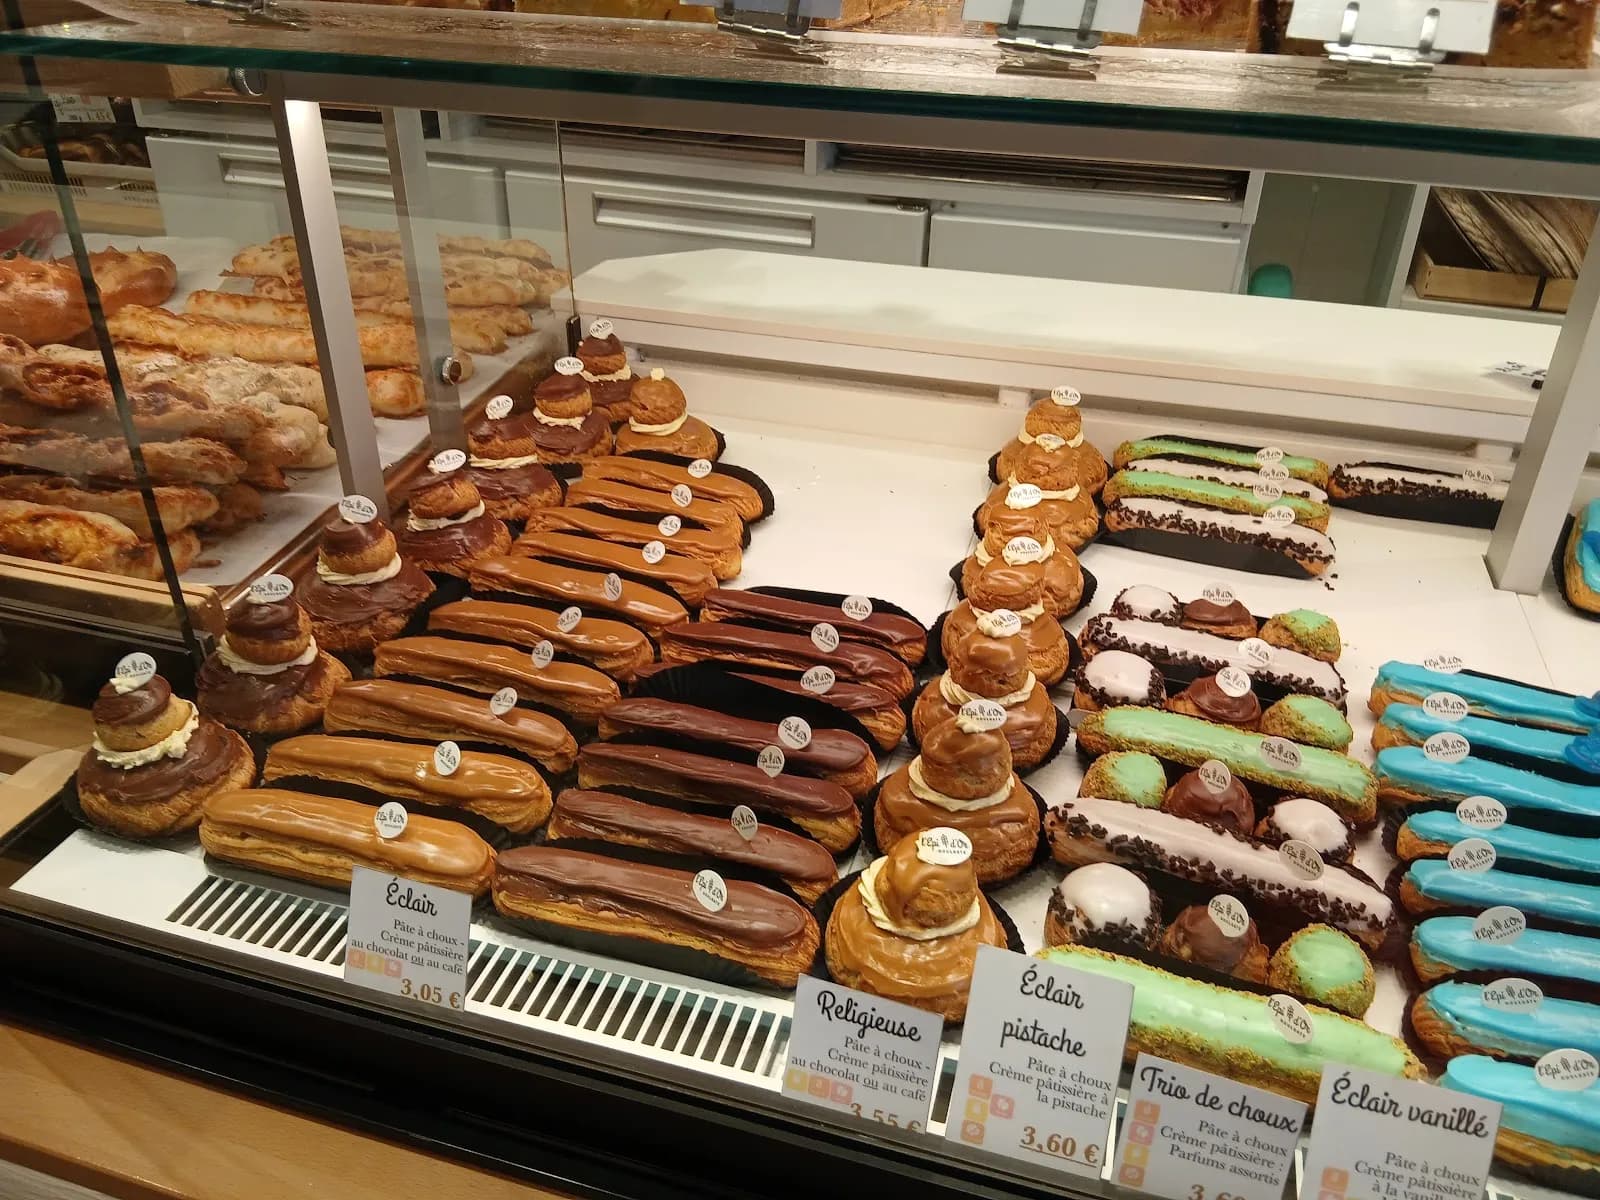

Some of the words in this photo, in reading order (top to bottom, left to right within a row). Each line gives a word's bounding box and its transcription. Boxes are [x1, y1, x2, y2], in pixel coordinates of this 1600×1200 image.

[386, 877, 437, 916] Éclair
[381, 930, 415, 948] Crème
[417, 942, 464, 961] pâtissière
[393, 919, 415, 934] Pâte
[418, 926, 424, 936] à
[427, 928, 457, 946] choux
[352, 938, 363, 949] au
[367, 940, 408, 961] chocolat
[411, 955, 424, 964] ou
[427, 958, 439, 968] au
[442, 964, 463, 975] café
[401, 979, 442, 1004] 3,05
[450, 992, 460, 1009] €
[1020, 964, 1084, 1009] Éclair
[817, 990, 921, 1042] Religieuse
[844, 1036, 870, 1053] Pâte
[874, 1046, 880, 1057] à
[884, 1050, 922, 1070] choux
[1000, 1018, 1086, 1057] pistache
[792, 1056, 806, 1067] au
[809, 1059, 859, 1083] chocolat
[863, 1078, 878, 1089] ou
[882, 1082, 897, 1094] au
[901, 1086, 926, 1102] café
[828, 1048, 868, 1069] Crème
[872, 1063, 928, 1087] pâtissière
[989, 1061, 1033, 1084] Crème
[1036, 1077, 1097, 1103] pâtissière
[1101, 1092, 1109, 1106] à
[1028, 1056, 1056, 1076] Pâte
[1059, 1066, 1067, 1079] à
[1071, 1071, 1111, 1091] choux
[850, 1103, 899, 1128] 355
[1037, 1090, 1048, 1104] la
[1052, 1095, 1106, 1120] pistache
[1140, 1066, 1191, 1100] Trio
[1195, 1084, 1223, 1110] de
[1228, 1096, 1298, 1133] choux
[1331, 1072, 1403, 1118] Éclair
[1407, 1107, 1489, 1138] vanillé
[1020, 1126, 1076, 1158] 3,60
[1084, 1144, 1099, 1164] €
[1161, 1125, 1207, 1149] Crème
[1210, 1143, 1275, 1169] pâtissière
[1198, 1120, 1228, 1138] Pâte
[1232, 1129, 1240, 1142] à
[1245, 1134, 1288, 1158] choux
[1169, 1144, 1225, 1170] Parfums
[1229, 1163, 1280, 1186] assortis
[1354, 1160, 1404, 1183] Crème
[1385, 1152, 1416, 1170] Pâte
[1420, 1161, 1429, 1174] à
[1434, 1166, 1480, 1187] choux
[1372, 1180, 1380, 1192] à
[1386, 1182, 1397, 1196] la
